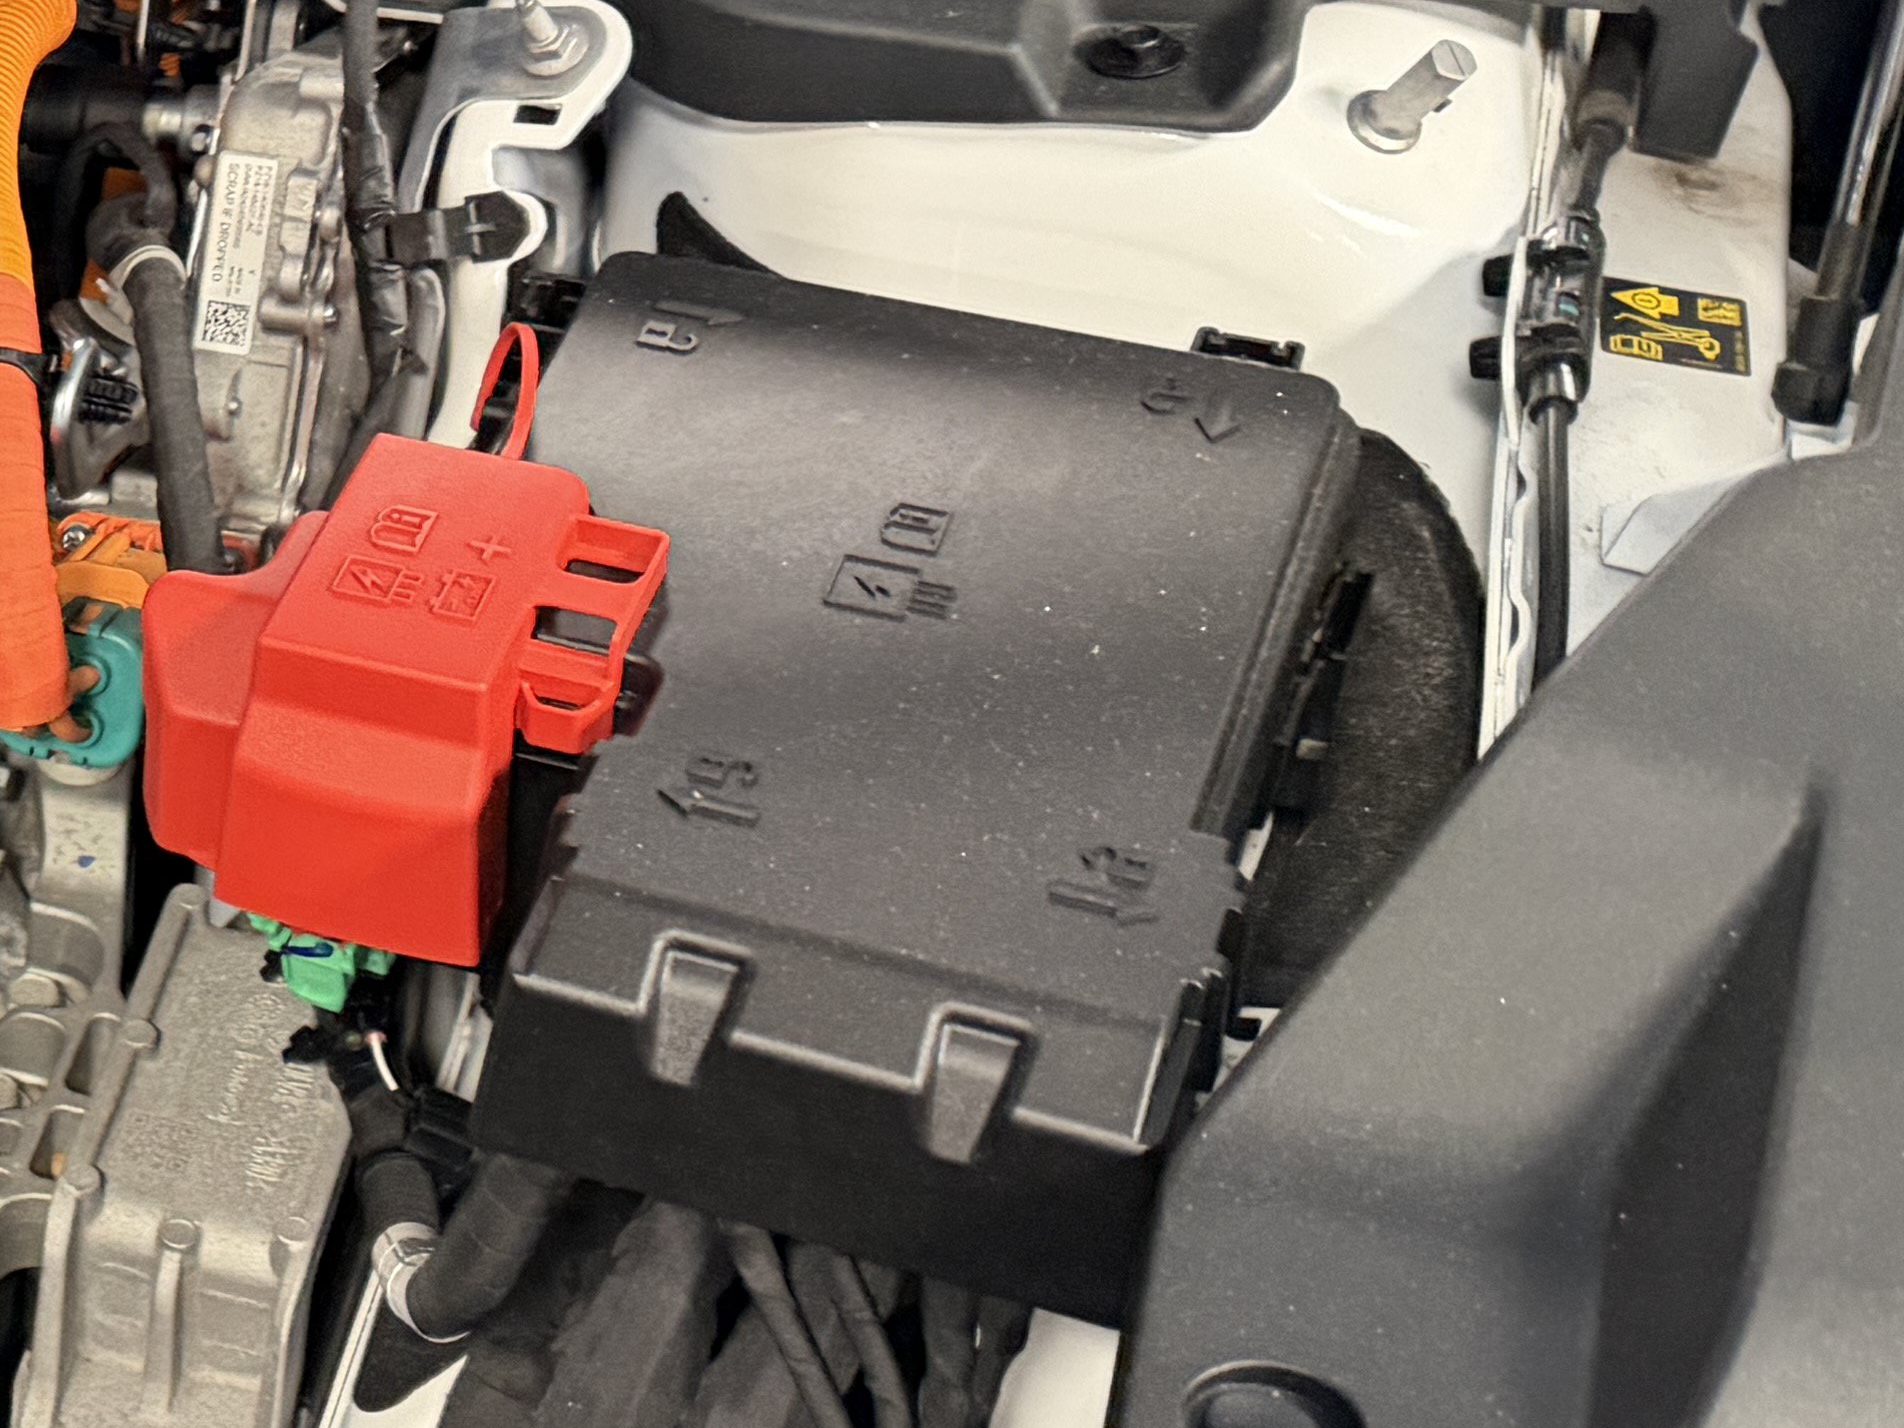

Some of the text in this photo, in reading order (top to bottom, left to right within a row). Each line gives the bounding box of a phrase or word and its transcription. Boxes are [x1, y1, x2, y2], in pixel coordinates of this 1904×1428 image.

[212, 163, 240, 282] SCRAP IF DROPPED
